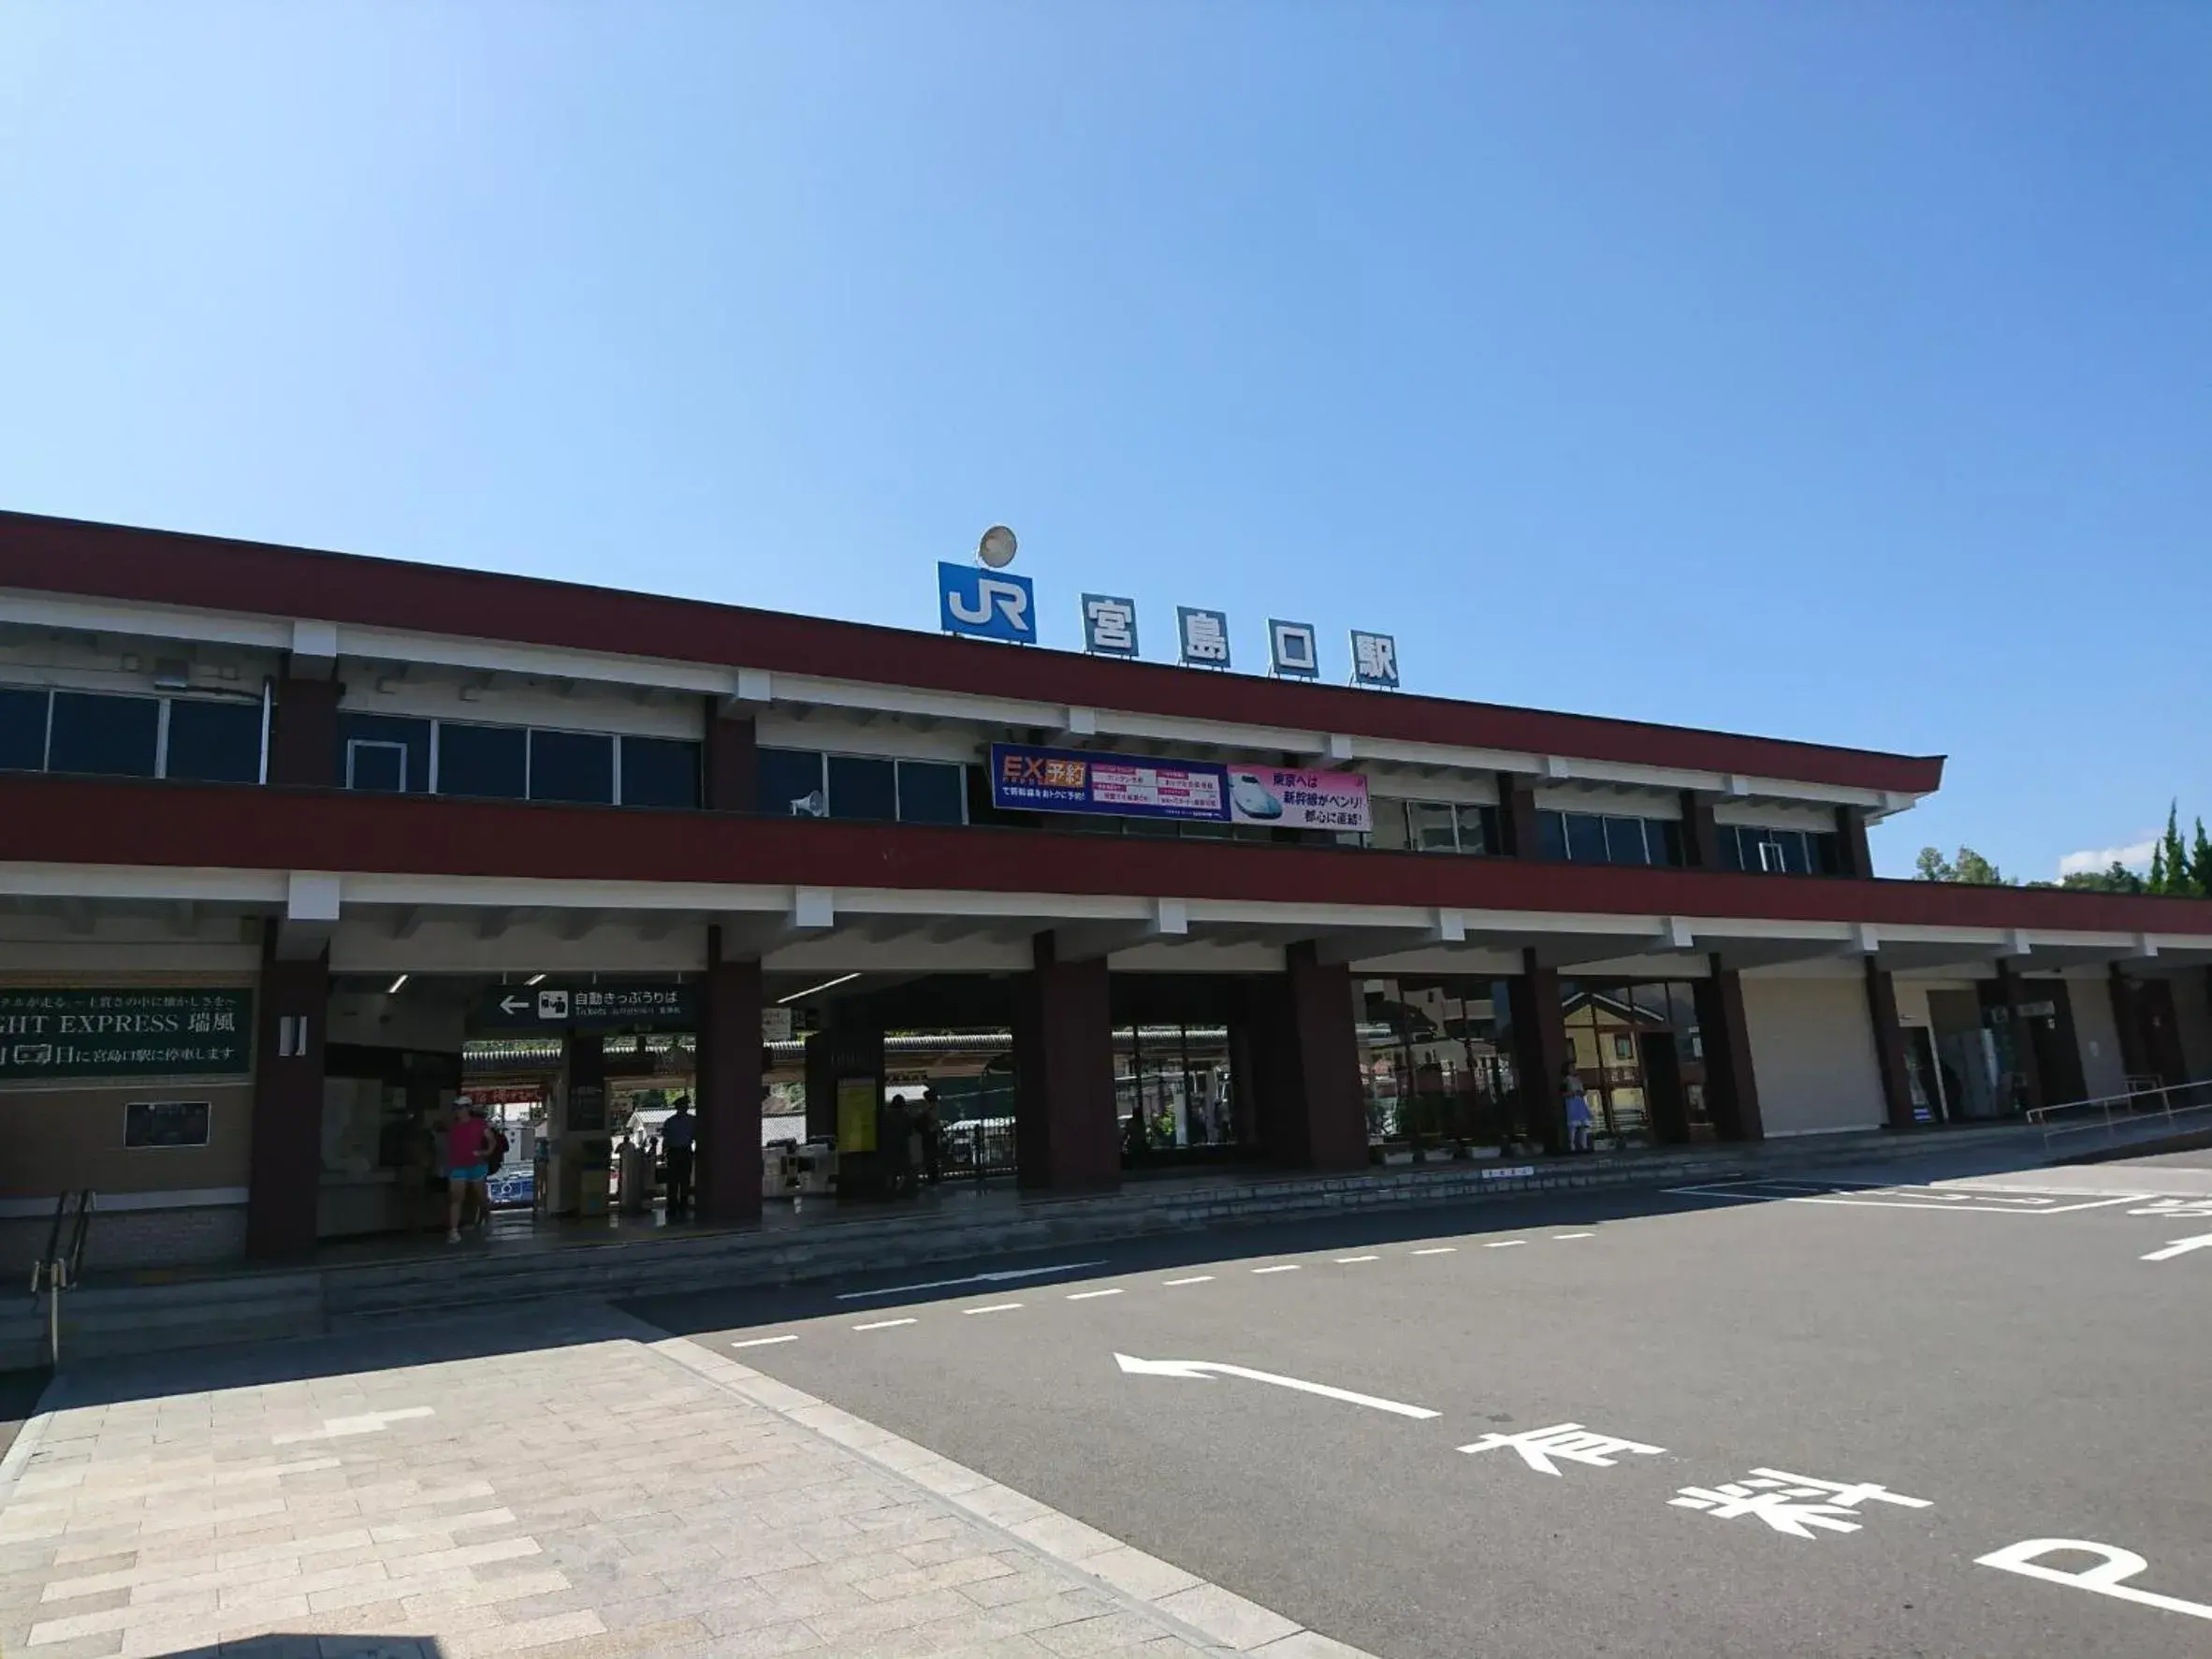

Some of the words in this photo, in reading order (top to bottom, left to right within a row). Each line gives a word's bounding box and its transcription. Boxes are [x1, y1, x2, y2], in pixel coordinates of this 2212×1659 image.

[949, 578, 1029, 632] JR
[1087, 599, 1398, 680] 宮島口駅
[1003, 754, 1085, 786] EX予約
[1273, 772, 1319, 788] 東京へは
[575, 991, 678, 1006] 自動きっぷうりば
[59, 1013, 179, 1033] EXPRESS
[187, 1011, 236, 1033] 瑞風
